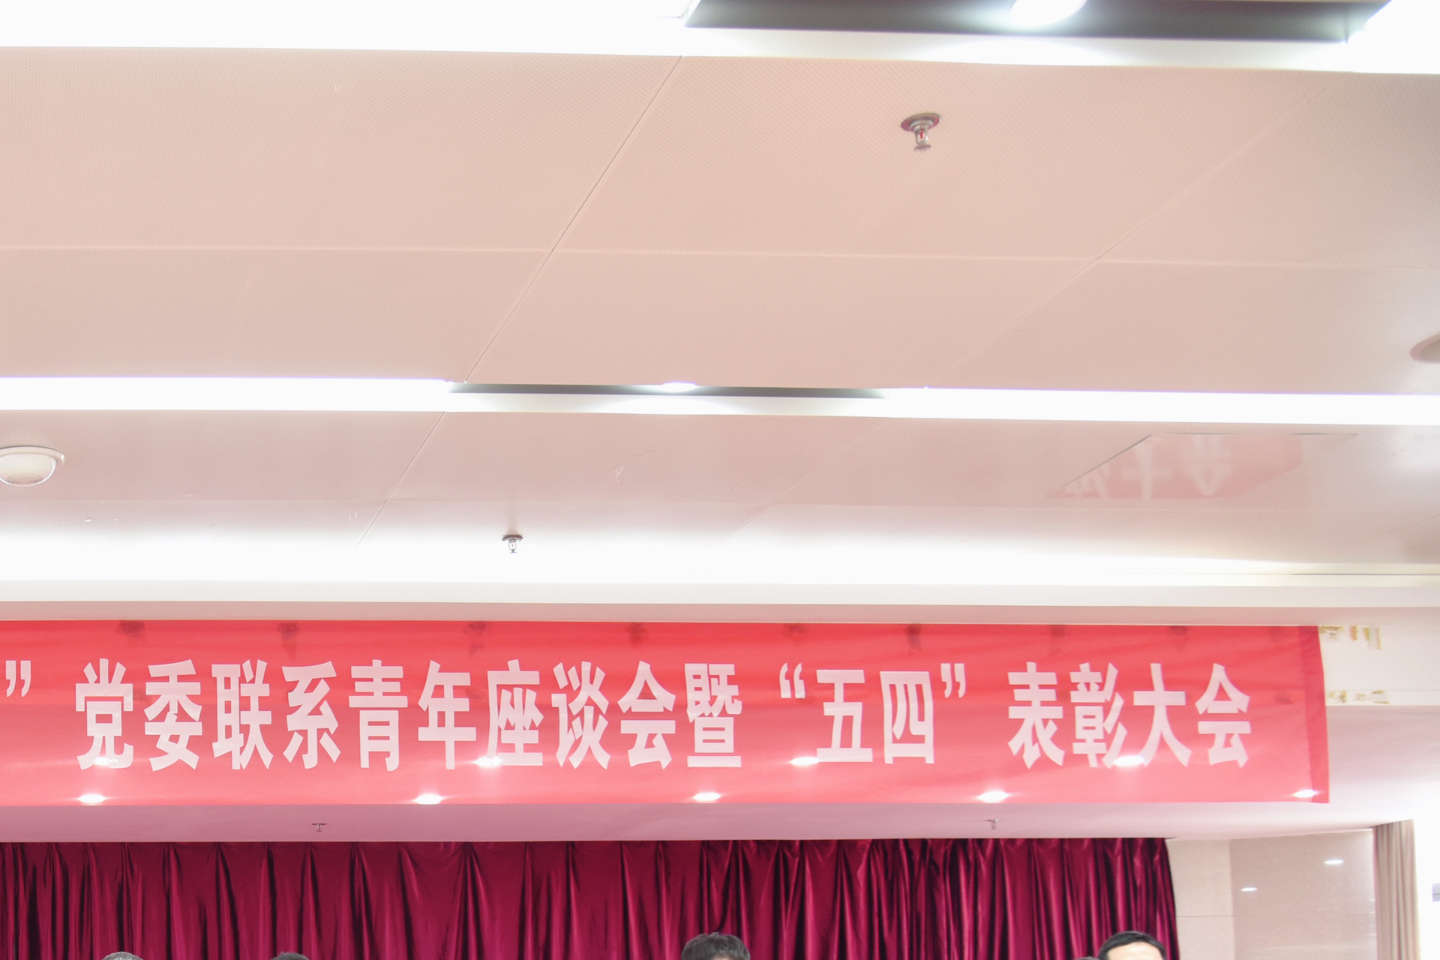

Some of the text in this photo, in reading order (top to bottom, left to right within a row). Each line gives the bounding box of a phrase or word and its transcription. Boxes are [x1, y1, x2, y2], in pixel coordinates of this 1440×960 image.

[75, 658, 742, 771] 党委联系青年座谈会暨
[779, 662, 966, 765] “五四”
[1008, 661, 1251, 769] 表彰大会
